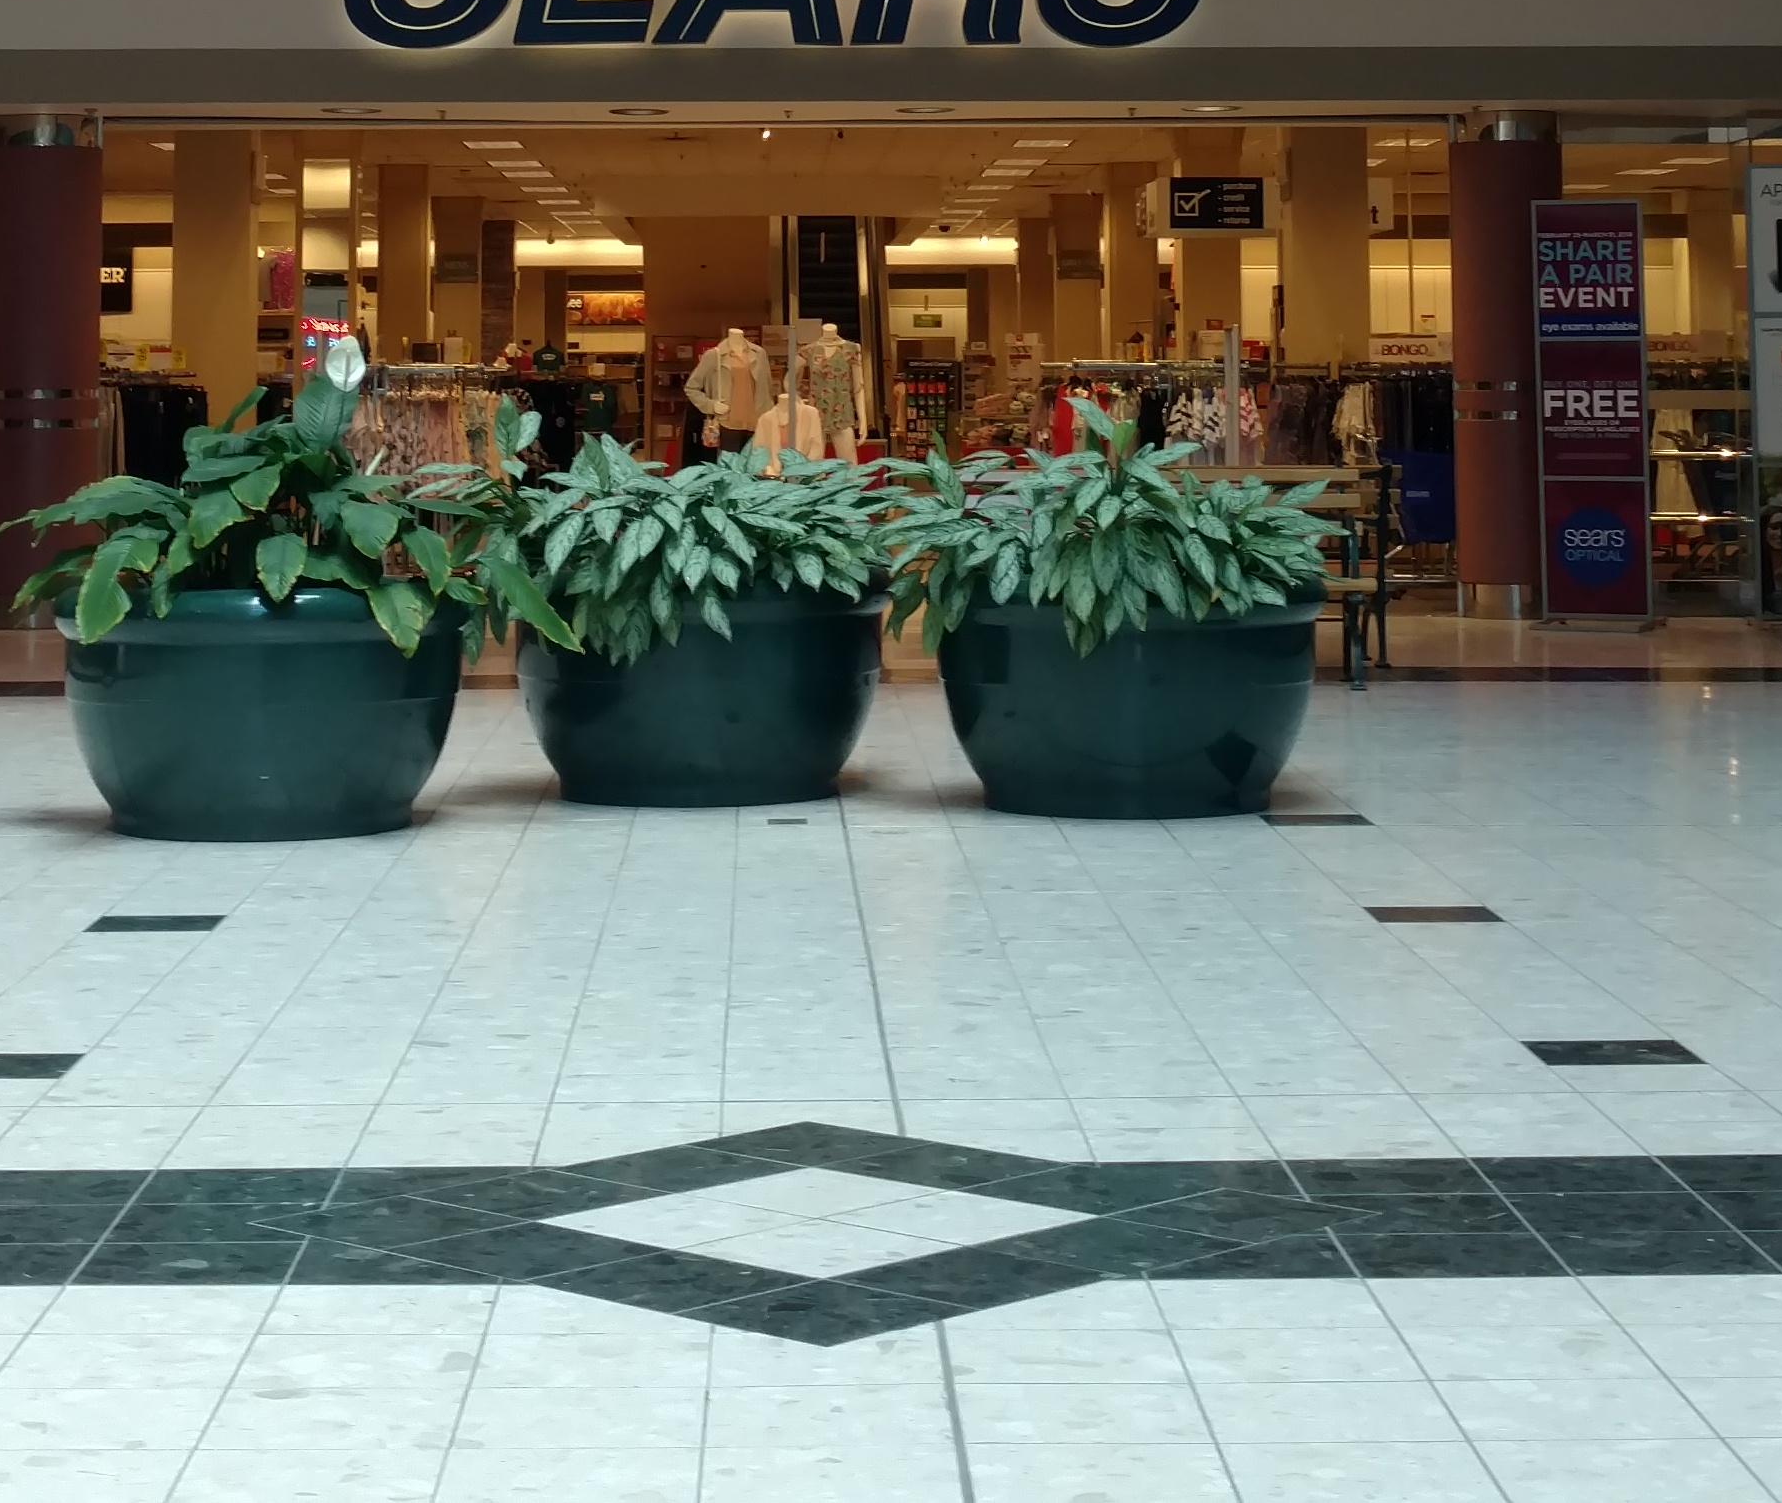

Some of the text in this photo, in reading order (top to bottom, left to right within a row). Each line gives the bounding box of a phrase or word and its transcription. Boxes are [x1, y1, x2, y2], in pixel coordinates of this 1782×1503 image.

[1539, 240, 1633, 261] SHARE
[1539, 263, 1633, 284] A PAIR
[1539, 287, 1635, 308] EVENT
[1542, 322, 1639, 333] eye exams available
[1381, 344, 1429, 356] BONGO
[1543, 390, 1640, 417] FREE
[1564, 529, 1623, 547] sears
[1564, 549, 1624, 561] OPTICAL
